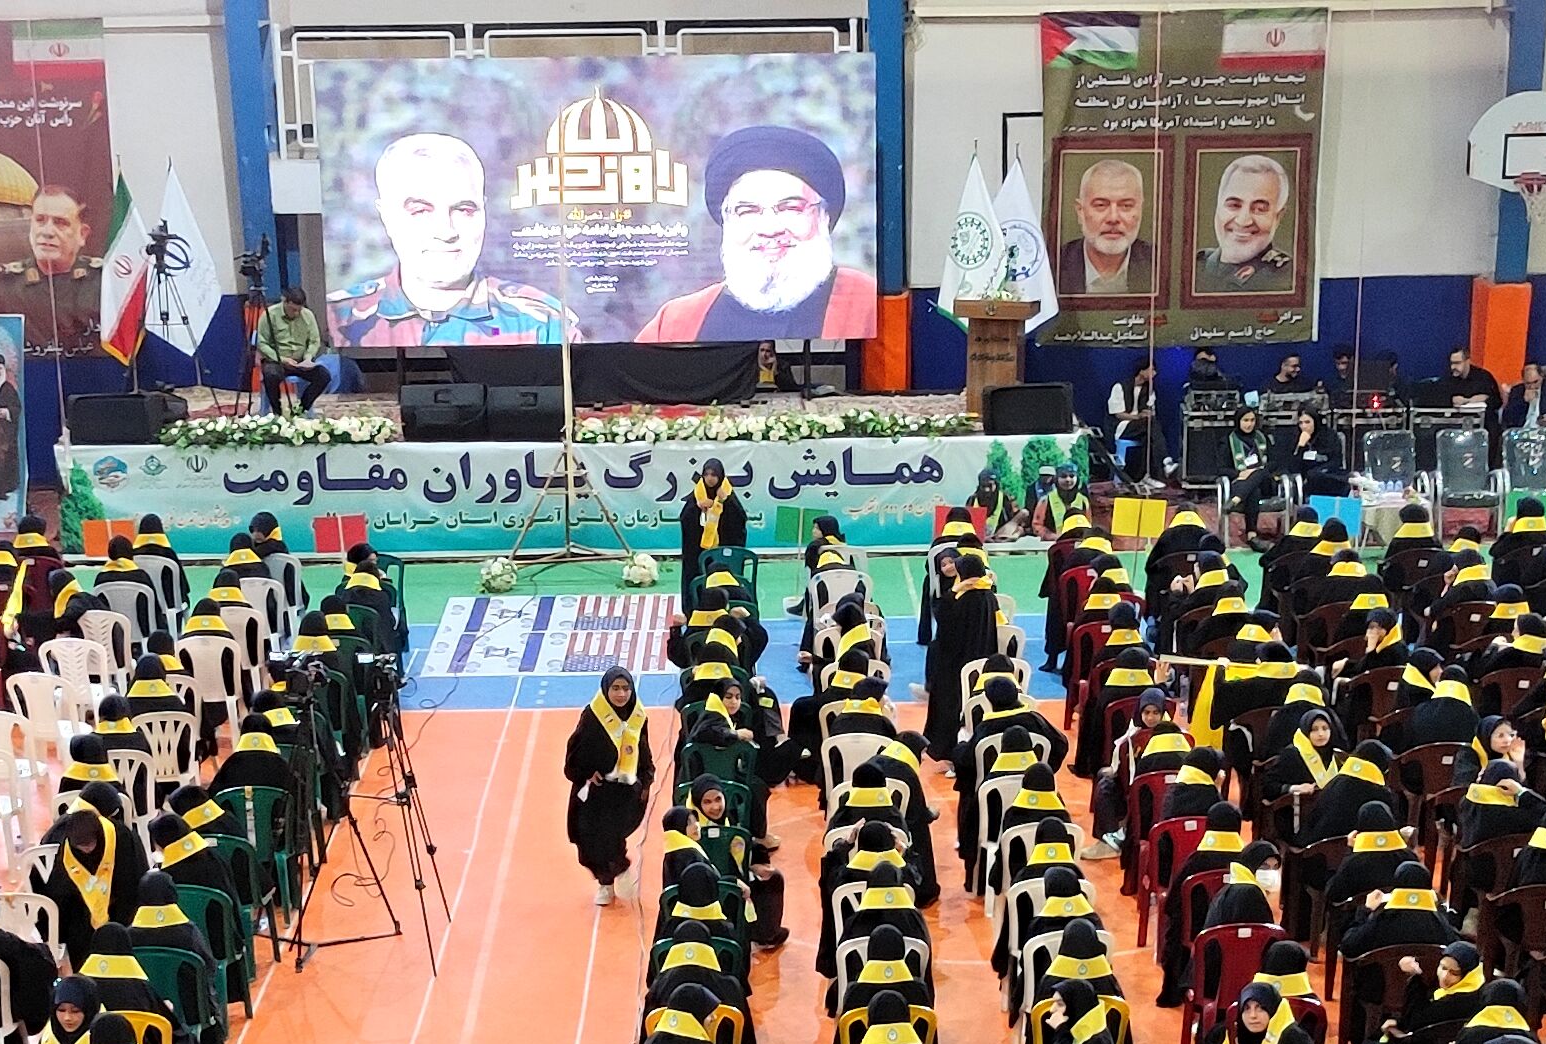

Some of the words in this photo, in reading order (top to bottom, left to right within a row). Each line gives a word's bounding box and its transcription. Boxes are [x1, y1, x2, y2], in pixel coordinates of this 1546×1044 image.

[223, 452, 409, 506] مقاومت
[423, 450, 587, 503] یاوران
[769, 446, 945, 500] همایش
[373, 511, 440, 530] خراسان
[445, 510, 498, 529] استان
[568, 509, 619, 528] دنش
[624, 509, 682, 528] ازمان
